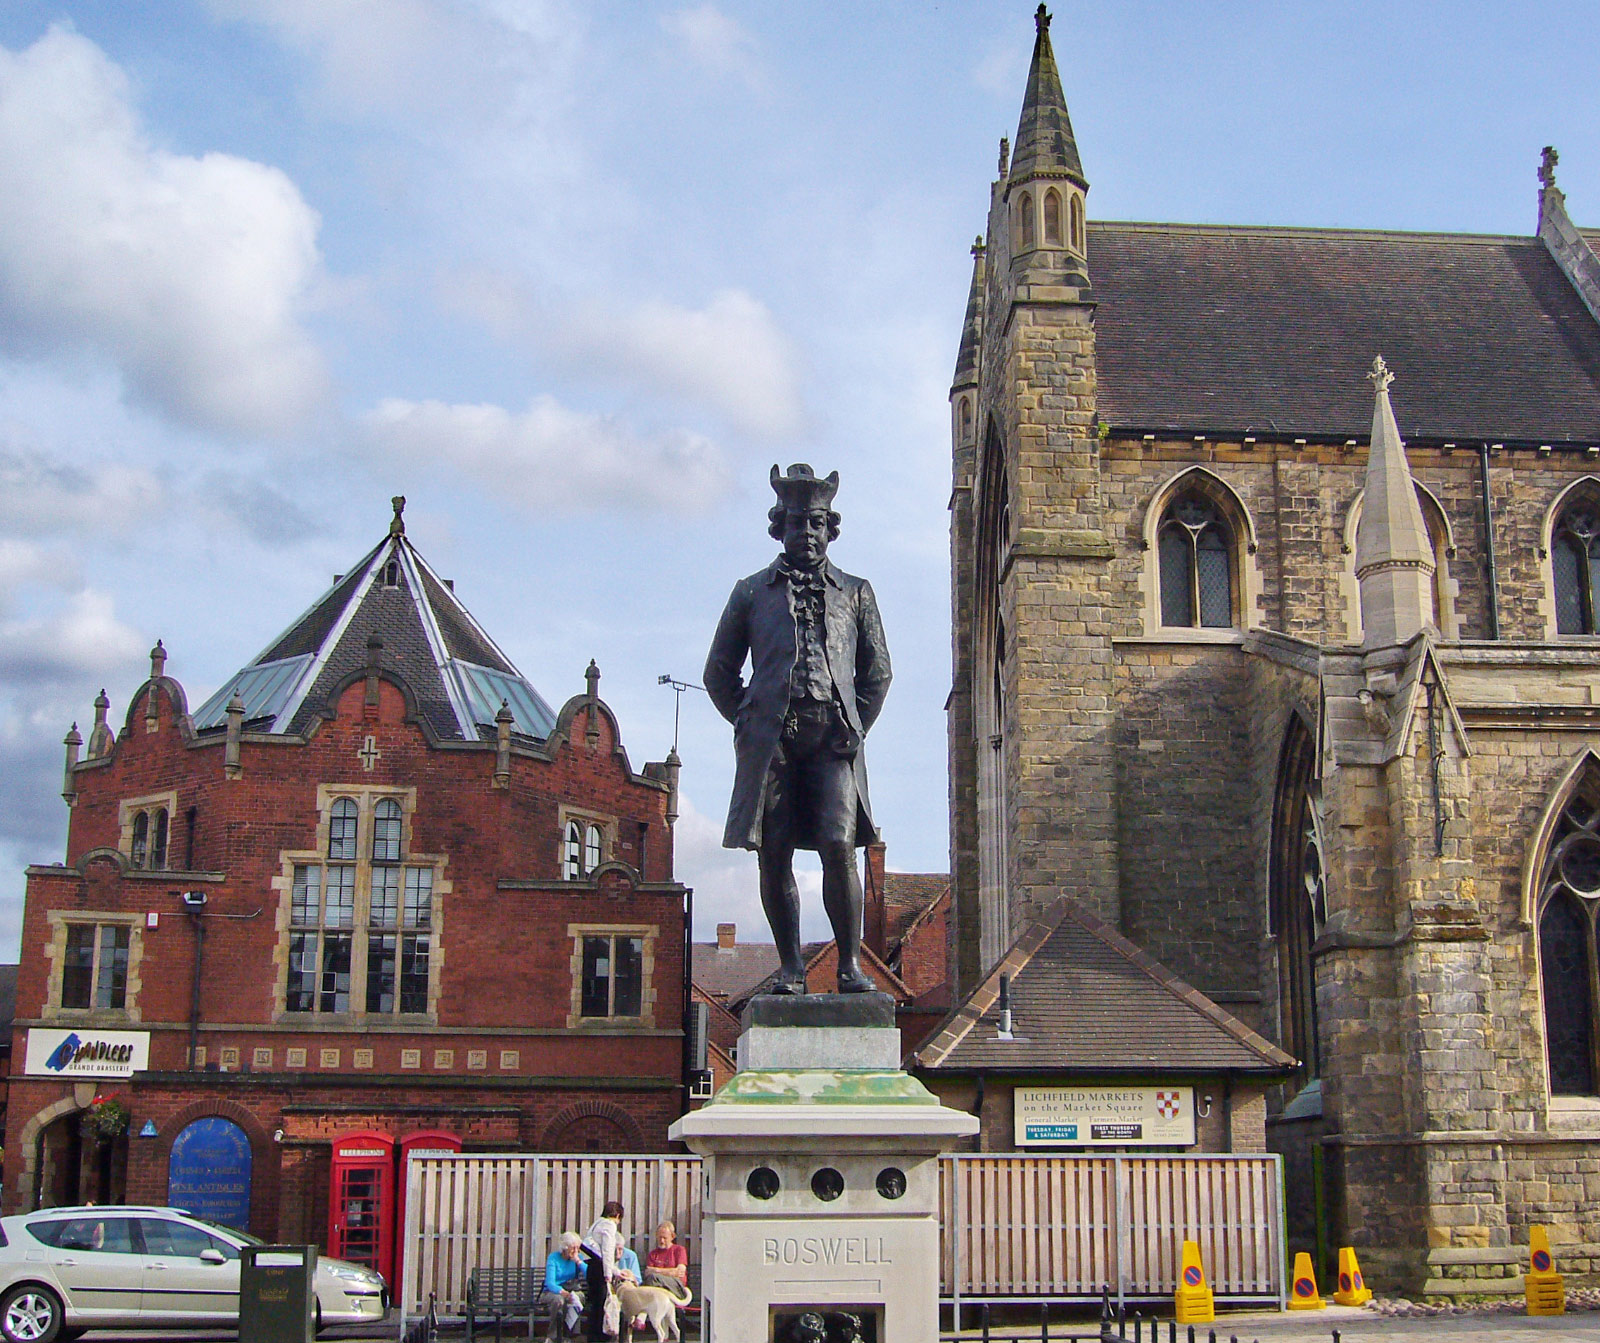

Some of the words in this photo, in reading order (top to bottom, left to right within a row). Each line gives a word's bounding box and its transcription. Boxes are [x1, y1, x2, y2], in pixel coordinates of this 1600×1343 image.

[60, 1040, 133, 1065] CHANDLERS
[96, 1064, 130, 1072] BRASSERIE
[1024, 1093, 1086, 1102] LICHFIELD
[1088, 1092, 1144, 1101] MARKETS
[1041, 1104, 1058, 1112] the
[1063, 1103, 1101, 1112] Market
[1106, 1103, 1144, 1114] Square
[1053, 1115, 1078, 1123] Market
[1118, 1115, 1144, 1123] Market
[763, 1238, 892, 1265] BOSWELL
